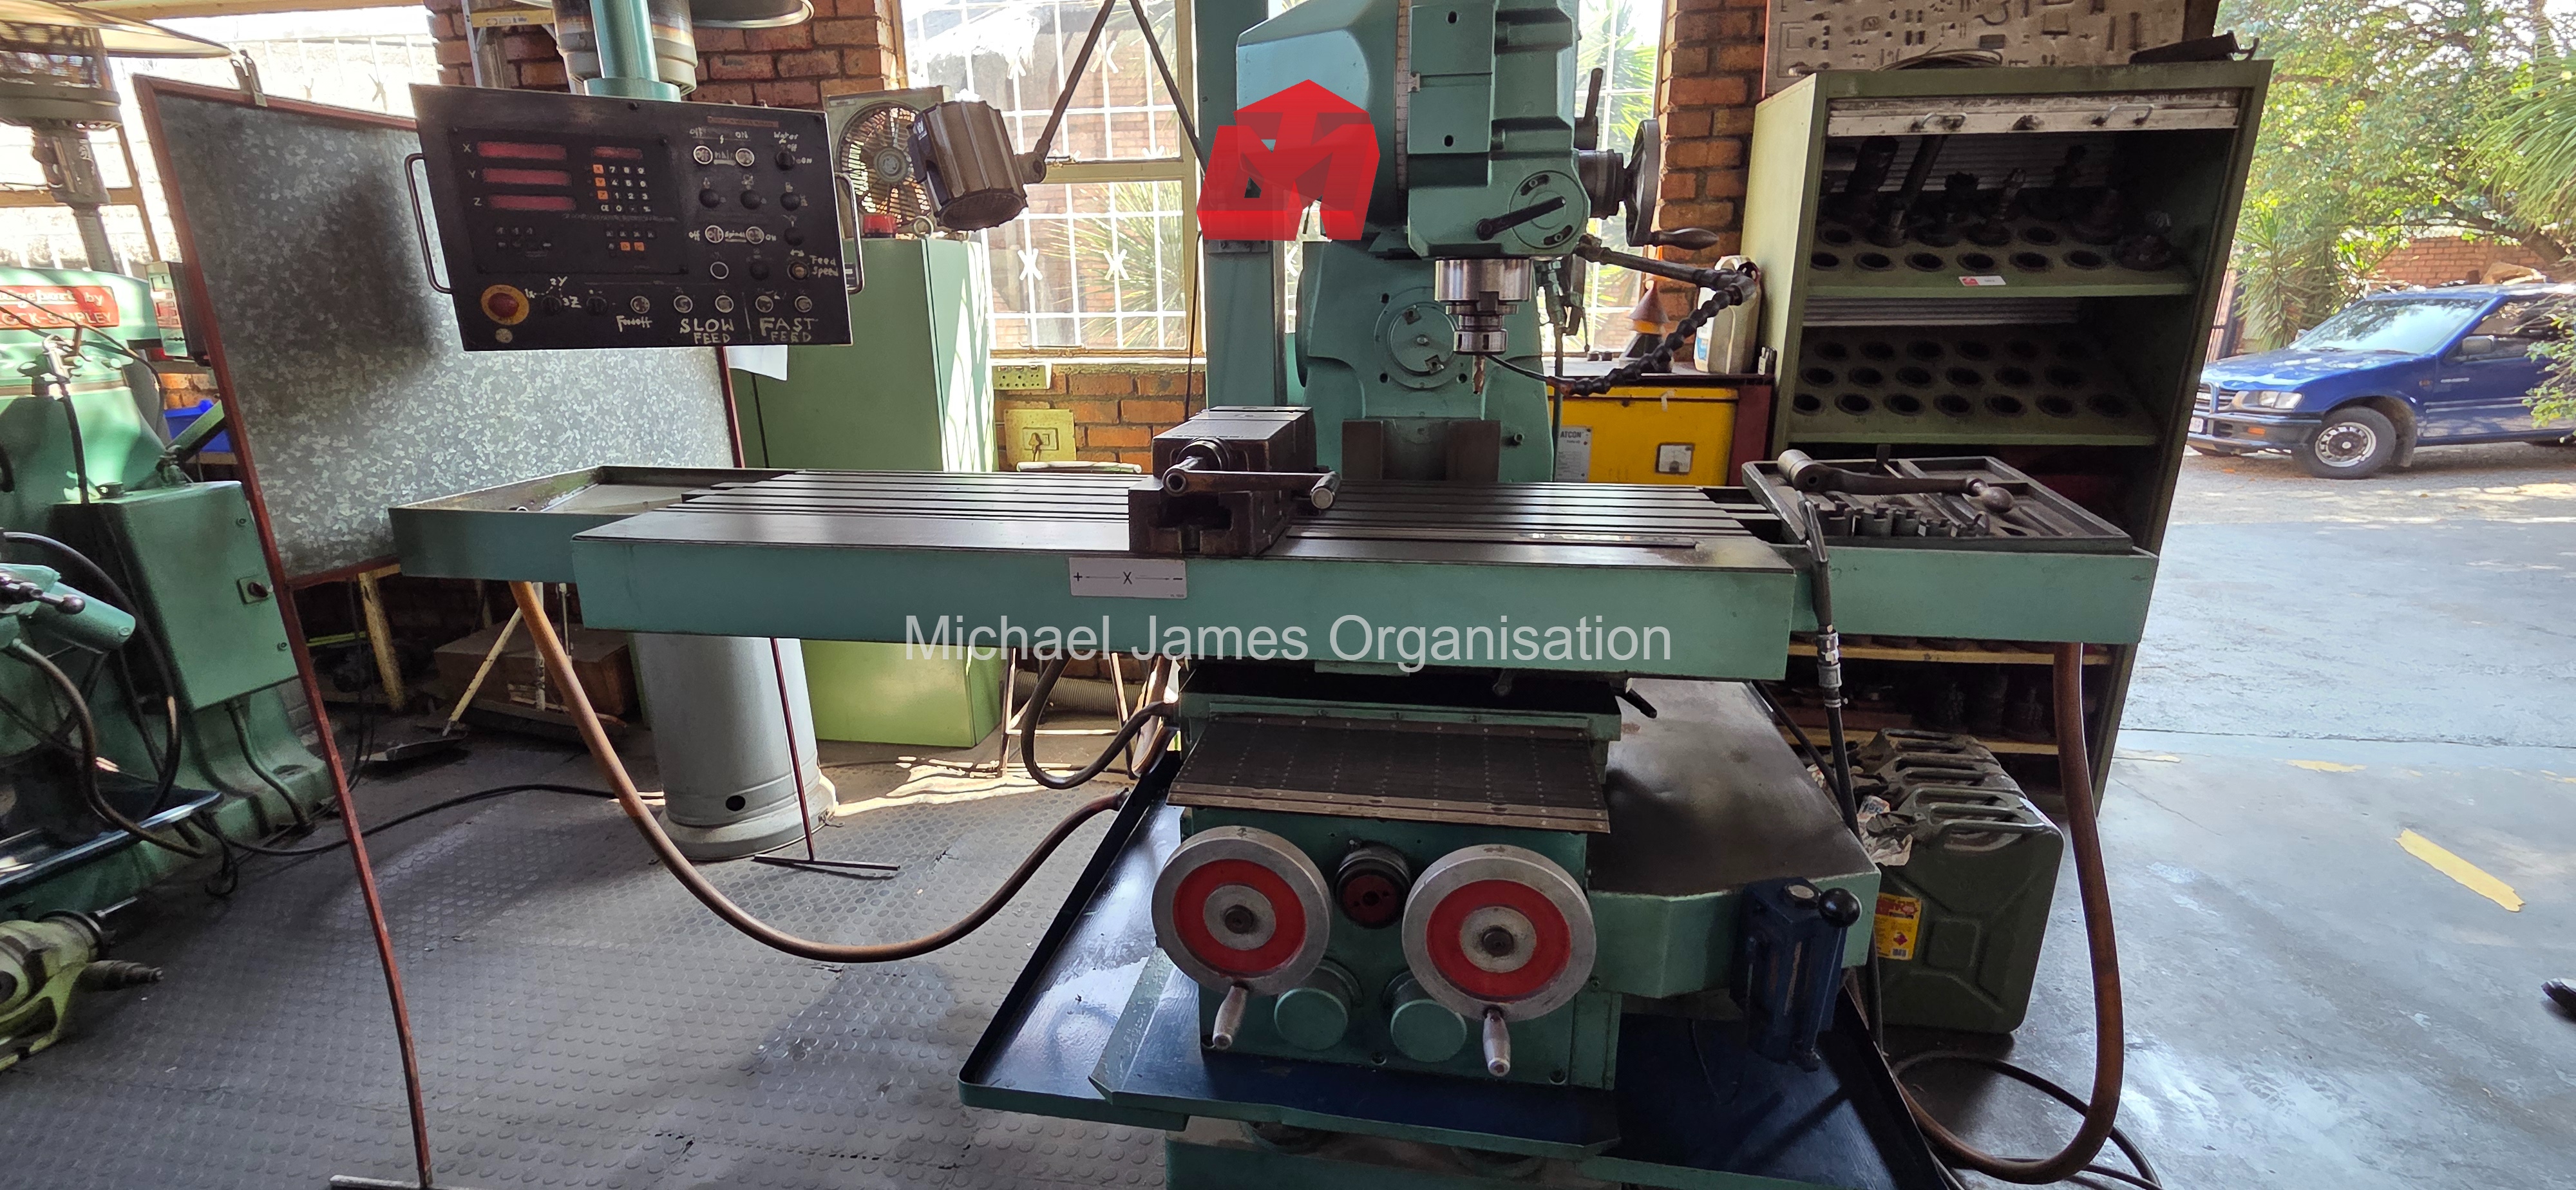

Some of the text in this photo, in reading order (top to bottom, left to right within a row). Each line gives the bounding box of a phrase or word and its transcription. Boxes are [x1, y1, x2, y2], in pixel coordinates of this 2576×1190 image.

[462, 144, 471, 153] X
[468, 169, 476, 178] Y
[473, 197, 482, 206] Z
[810, 255, 837, 266] Feed
[84, 292, 103, 307] by
[680, 317, 816, 336] SLOW FAST
[694, 331, 812, 345] FEED FEED
[1123, 571, 1133, 585] X
